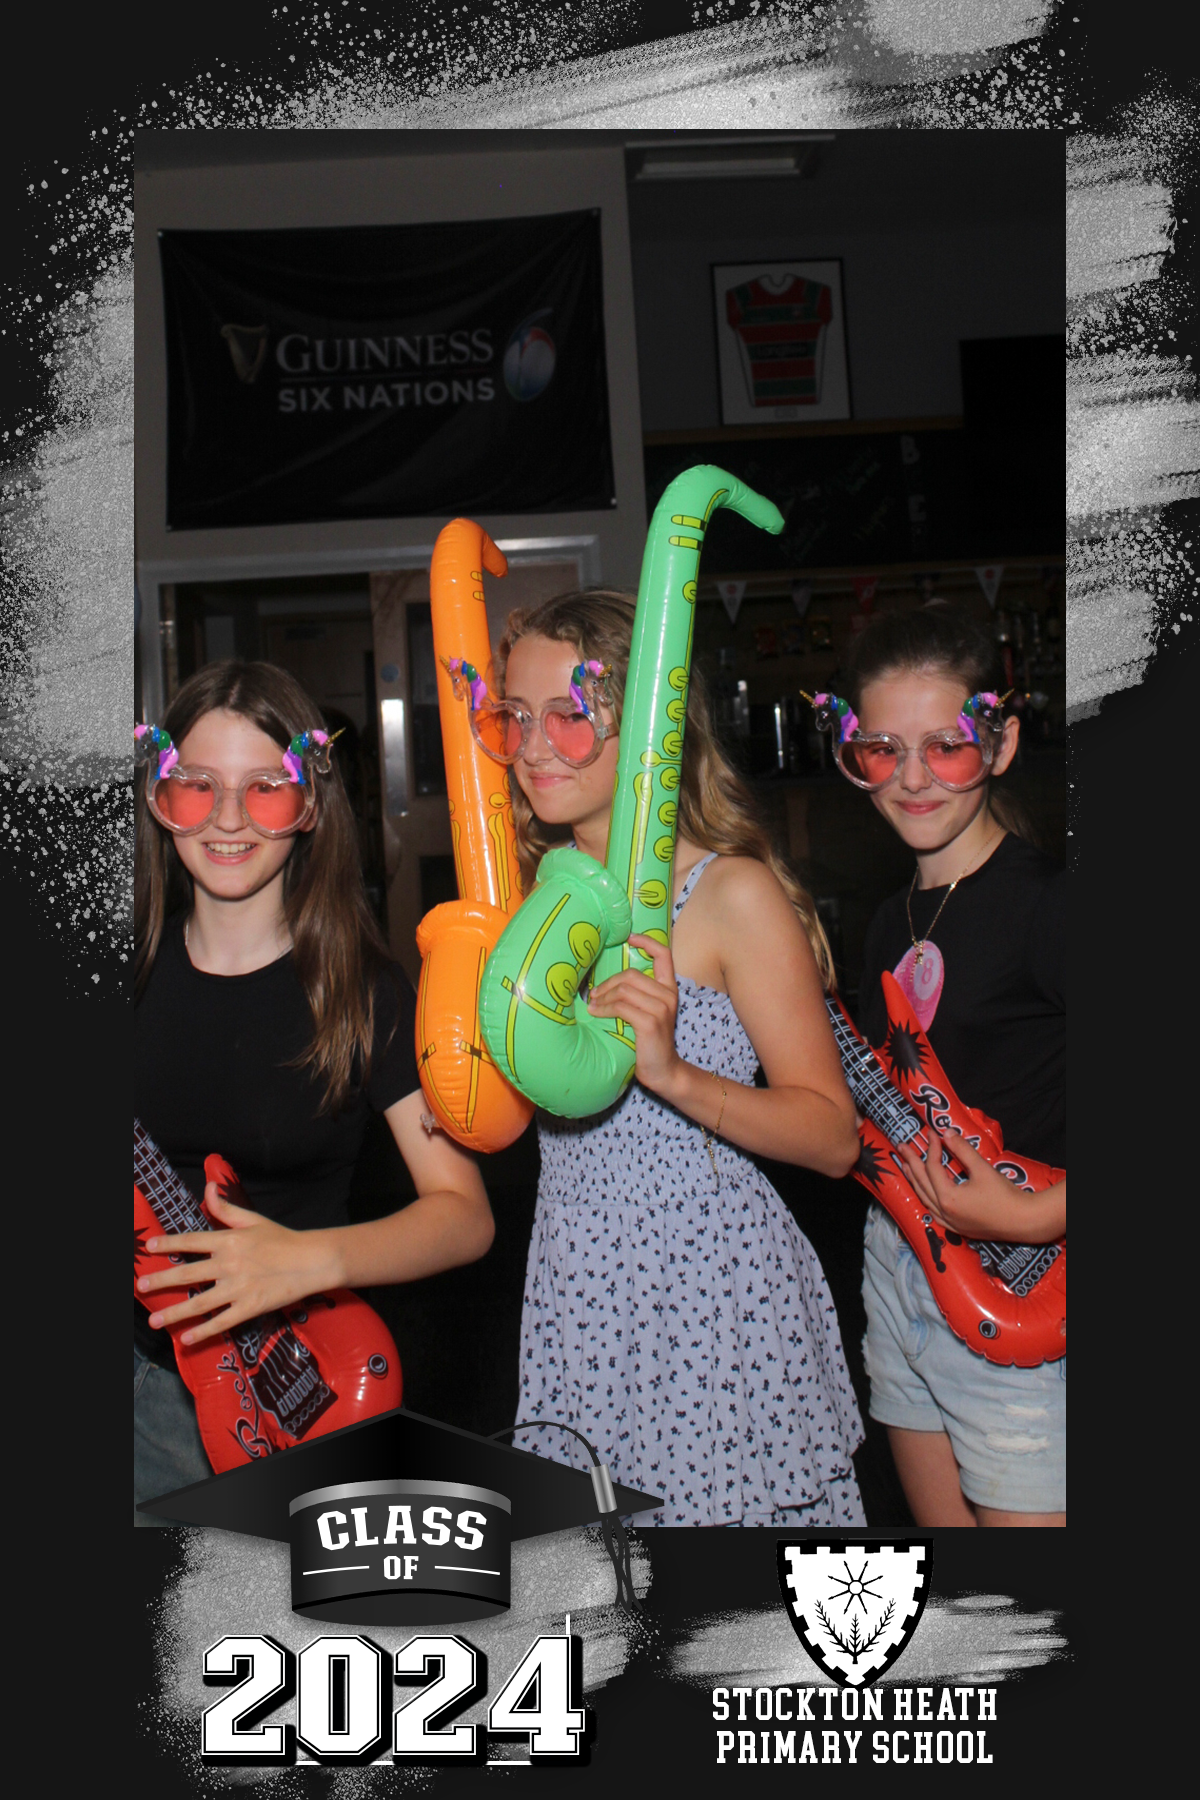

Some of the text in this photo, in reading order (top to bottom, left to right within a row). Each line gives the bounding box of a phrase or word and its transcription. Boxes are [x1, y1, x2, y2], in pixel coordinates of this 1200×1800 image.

[276, 329, 493, 373] GUINNESS
[278, 378, 495, 412] SIX NATIONS
